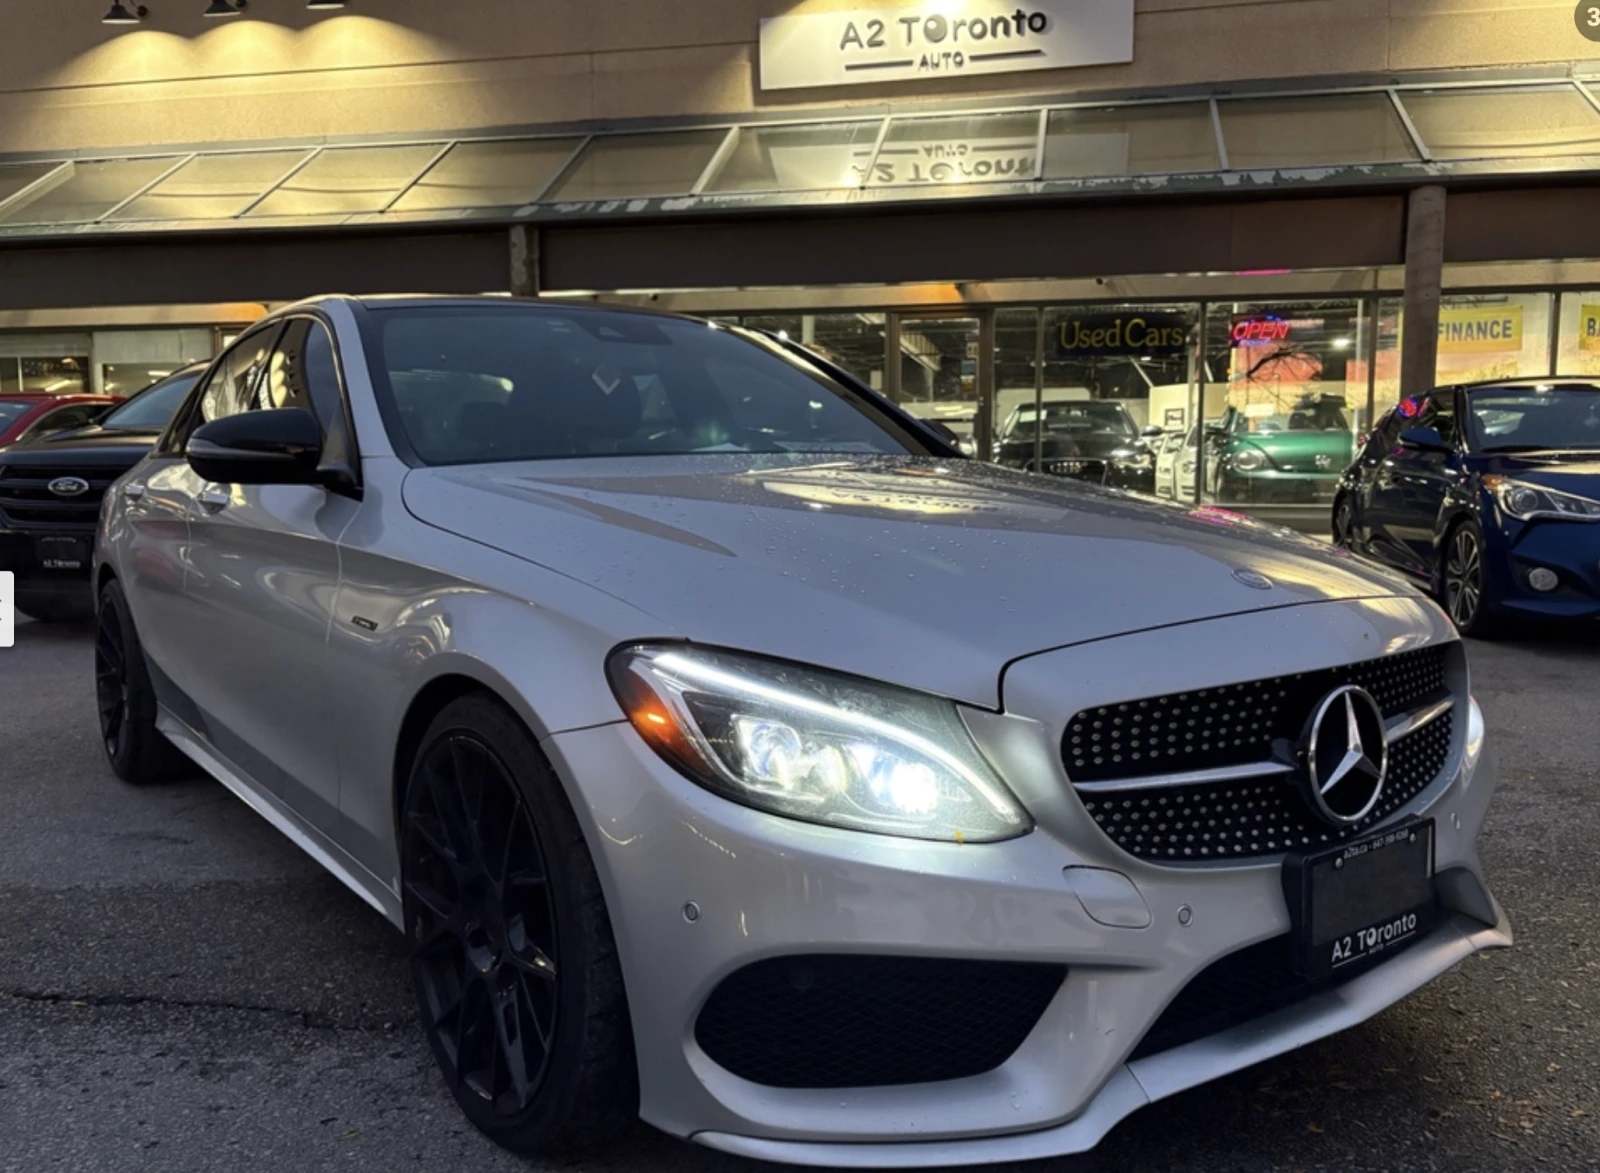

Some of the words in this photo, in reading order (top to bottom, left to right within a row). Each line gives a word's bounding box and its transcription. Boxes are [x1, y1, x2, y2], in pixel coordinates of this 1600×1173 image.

[840, 19, 885, 50] A2
[919, 51, 965, 70] AUTO
[1060, 319, 1121, 349] Used
[1125, 318, 1183, 348] Cars
[1233, 321, 1291, 340] OPEN
[1587, 317, 1600, 337] B
[1331, 936, 1352, 962] A2
